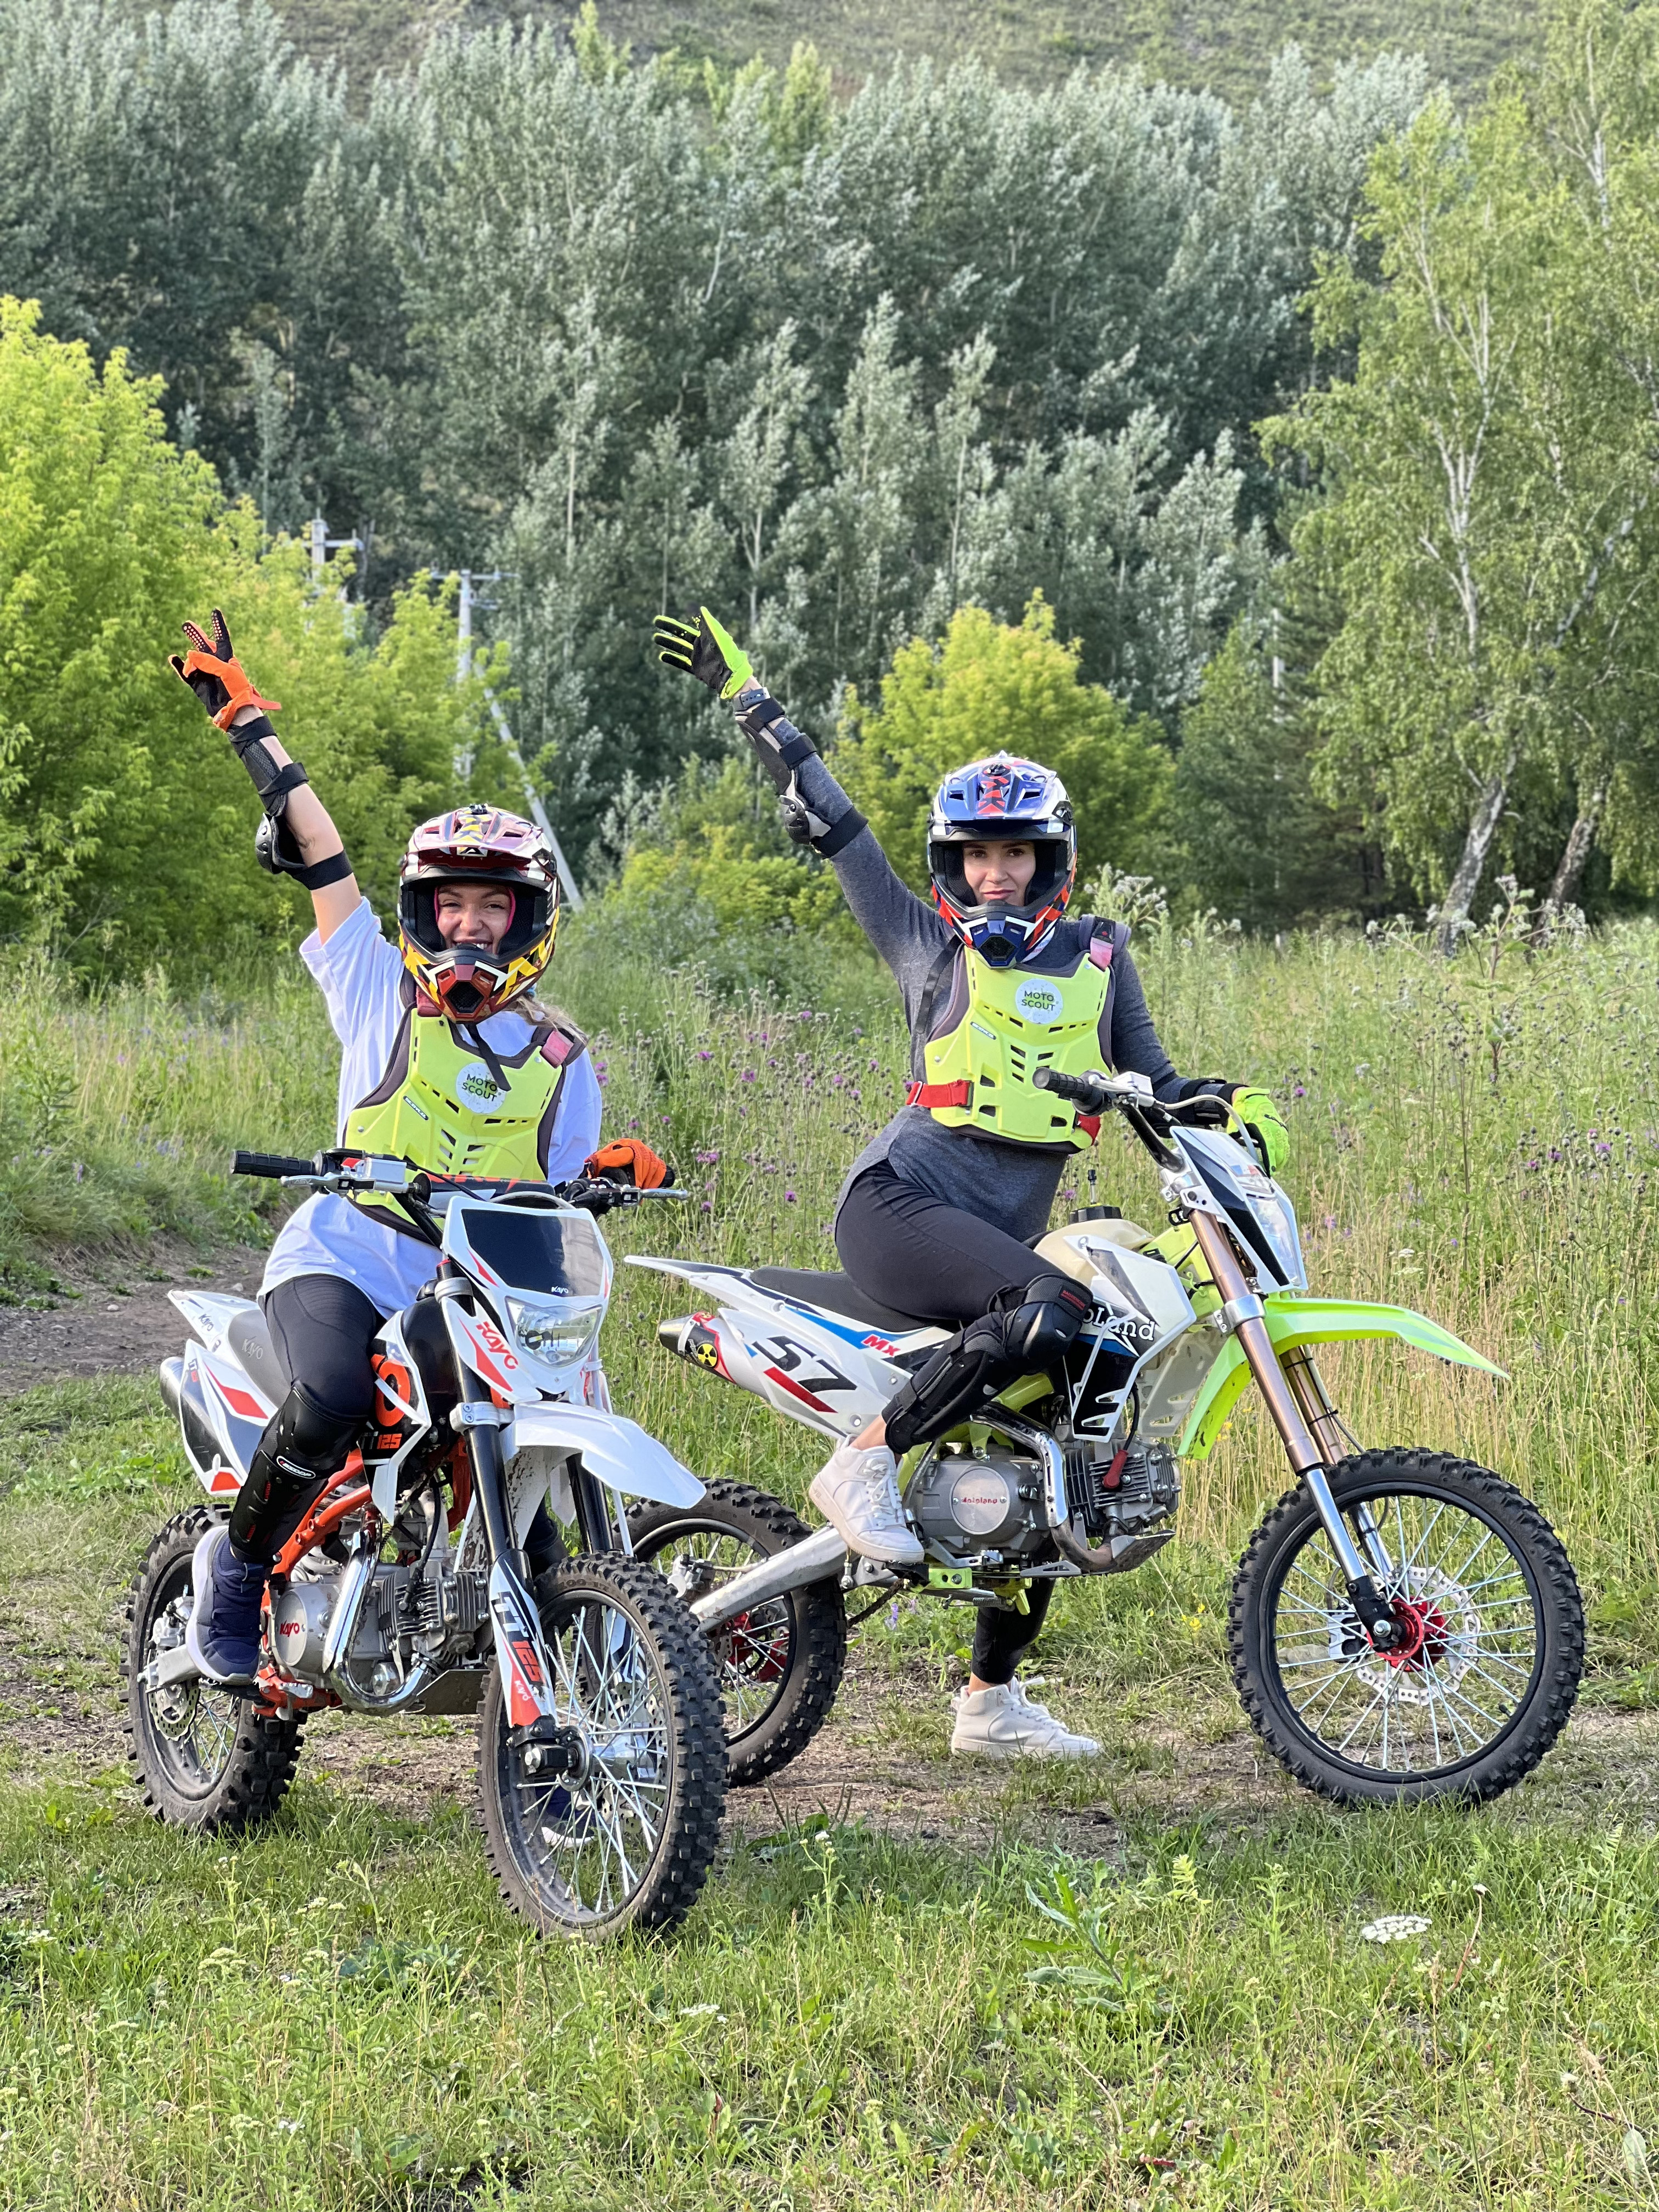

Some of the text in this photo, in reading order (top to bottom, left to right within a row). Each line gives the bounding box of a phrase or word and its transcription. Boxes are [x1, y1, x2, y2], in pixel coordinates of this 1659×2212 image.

[1021, 998, 1056, 1011] SCOUT
[1024, 990, 1054, 1002] MOTO
[461, 1082, 497, 1102] SCOUT
[466, 1073, 497, 1092] MOTO
[551, 1285, 569, 1294] KAYO
[752, 1335, 857, 1393] 57
[280, 1619, 300, 1638] KAYO
